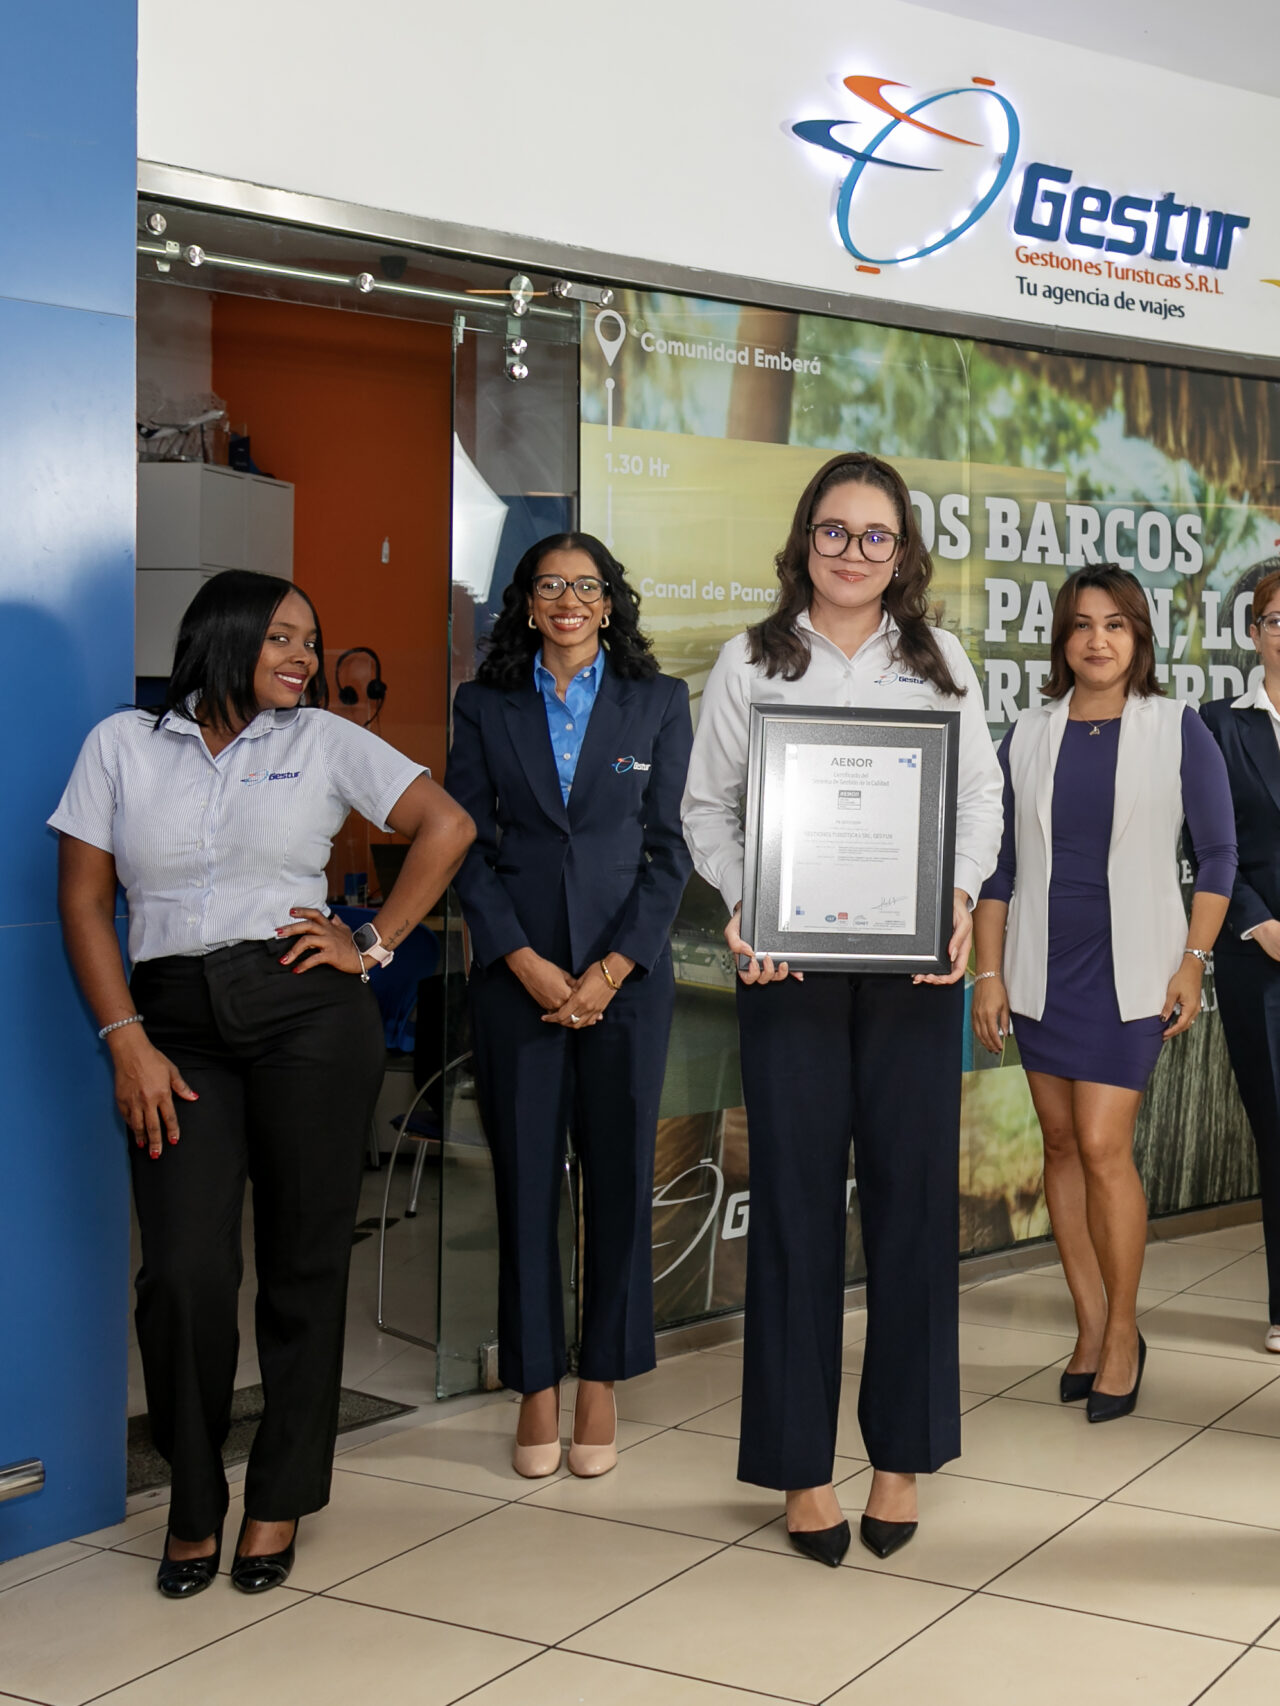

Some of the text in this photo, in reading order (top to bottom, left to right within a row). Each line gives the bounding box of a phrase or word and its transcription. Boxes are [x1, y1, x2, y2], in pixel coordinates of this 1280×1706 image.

[1013, 162, 1250, 270] Gestur
[1015, 246, 1102, 276] Gestiones
[1016, 276, 1185, 319] Tu agencia de viajes
[640, 332, 821, 375] Comunidad Emberá
[604, 453, 670, 478] 1.30 Hr
[907, 490, 1204, 574] OS BARCOS
[639, 577, 782, 602] Canal de Pana
[269, 771, 300, 780] Gestur
[830, 757, 873, 768] AENOR
